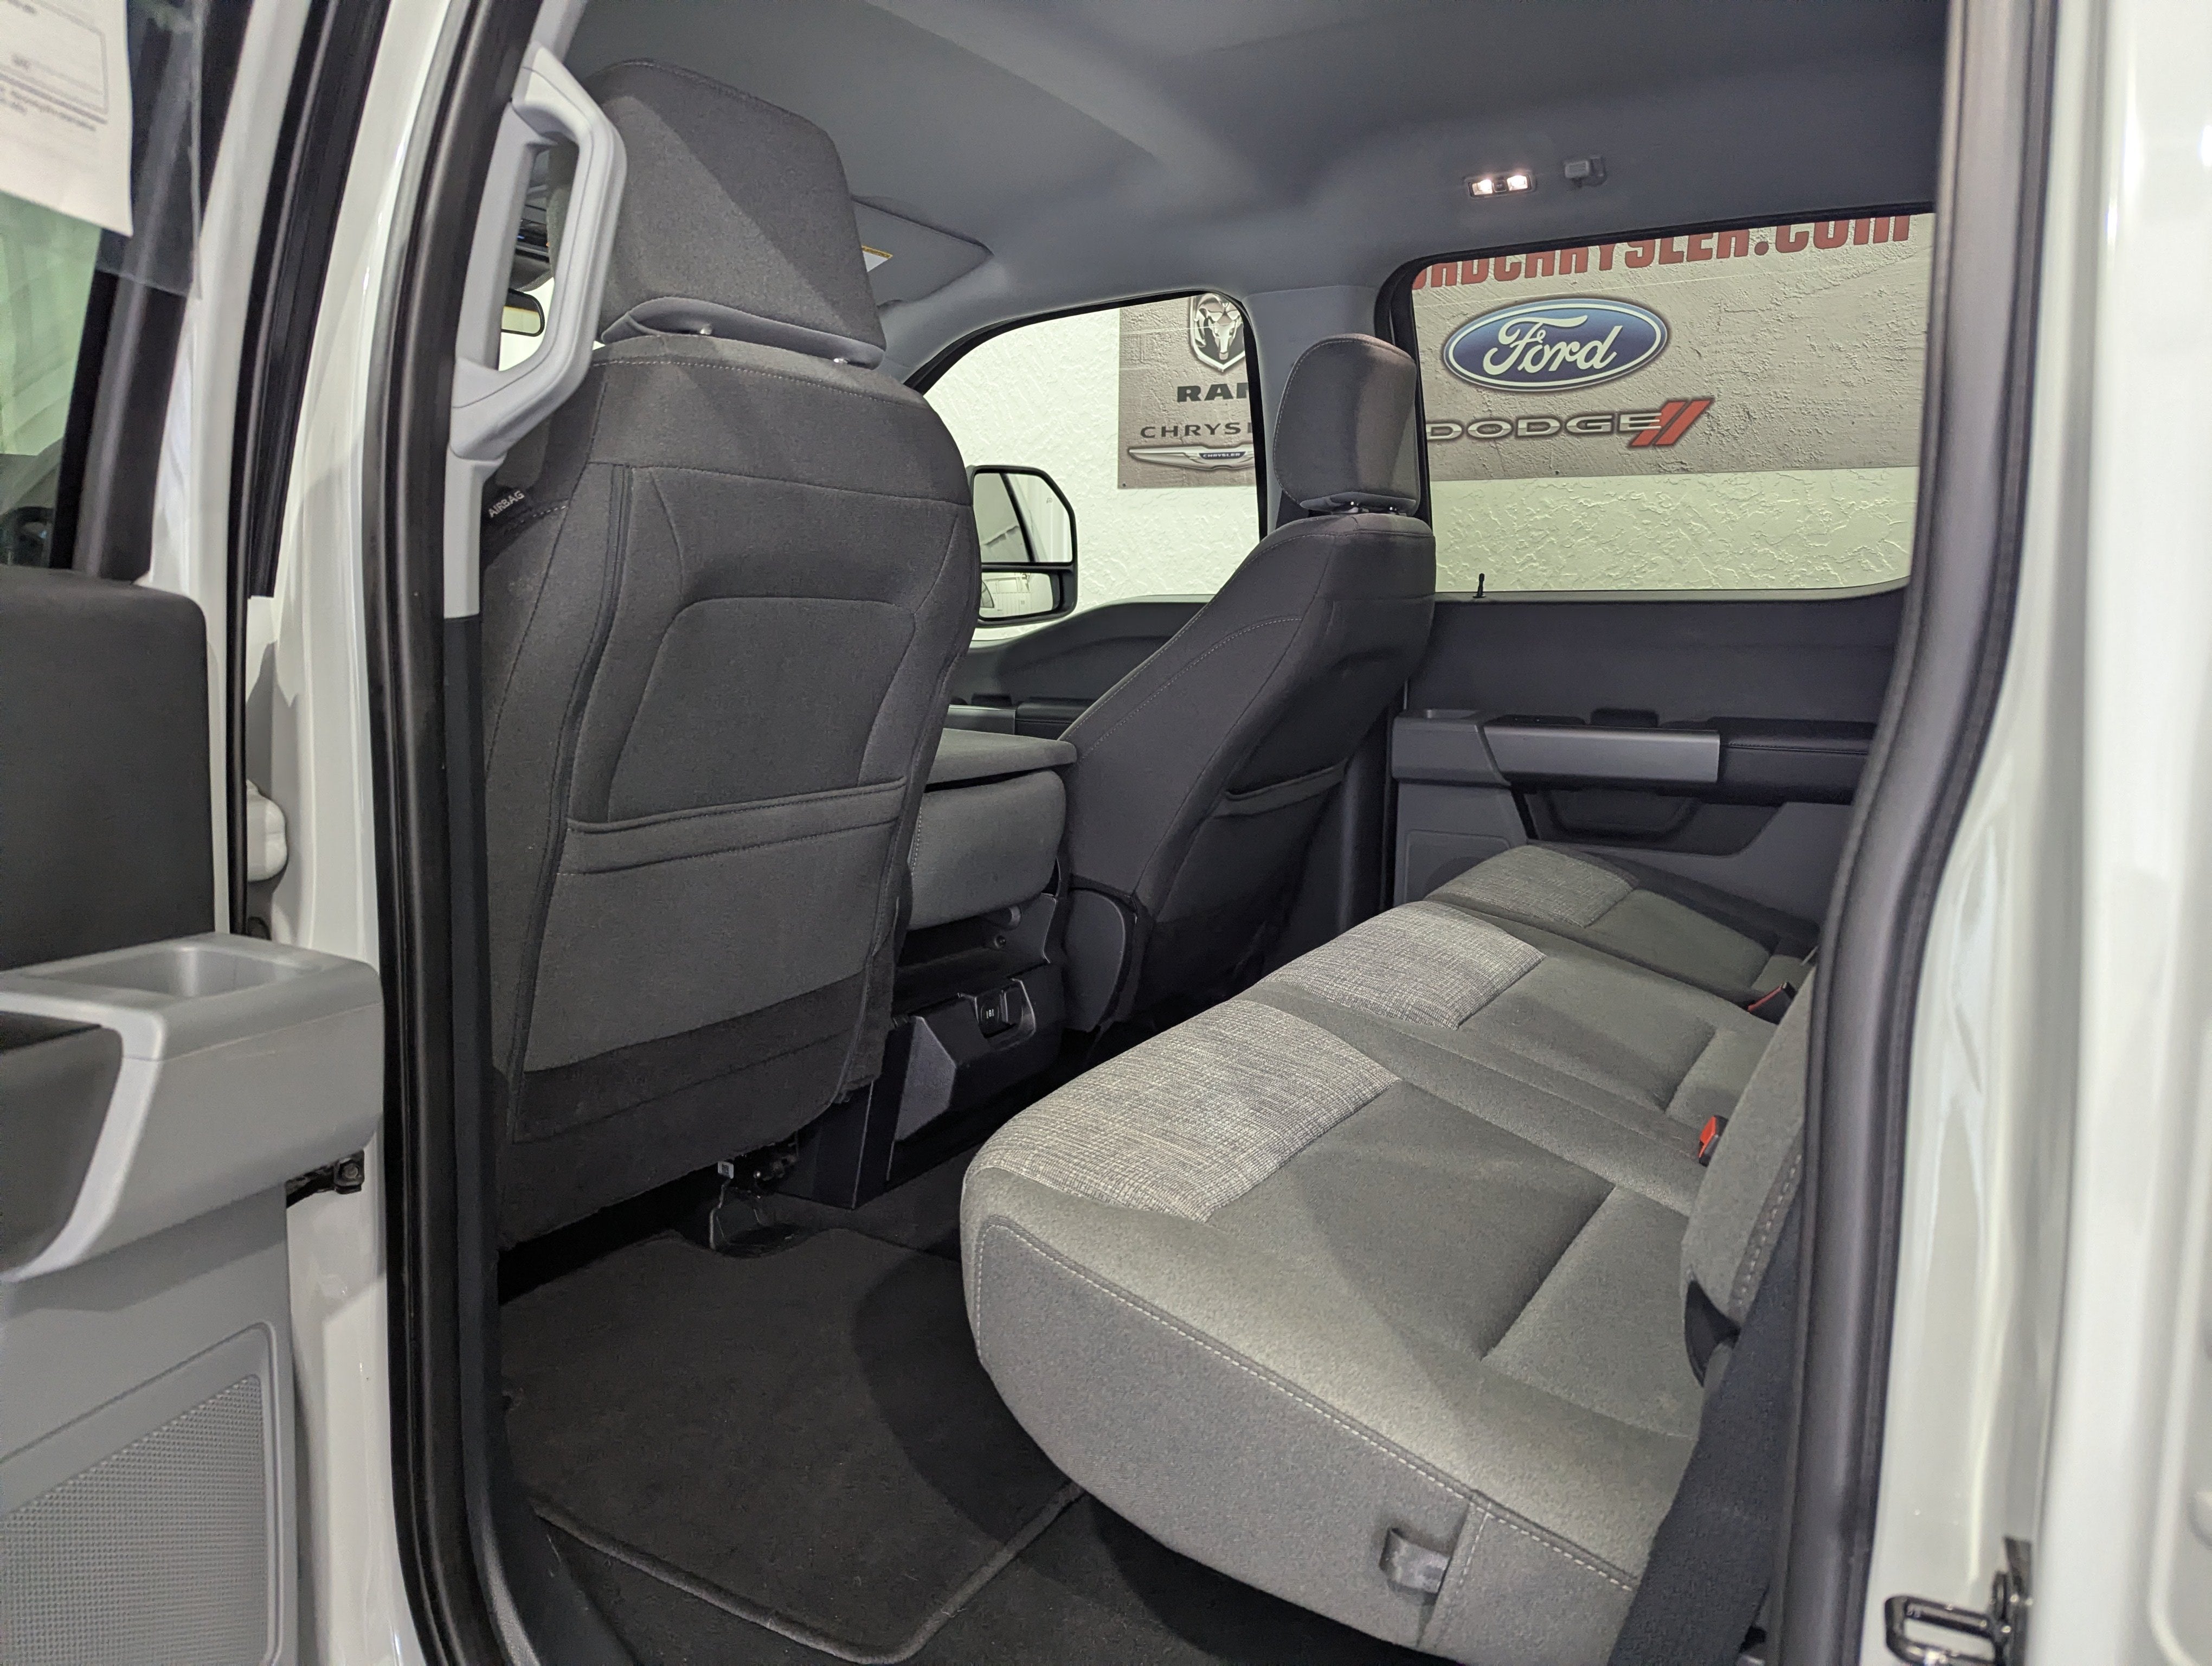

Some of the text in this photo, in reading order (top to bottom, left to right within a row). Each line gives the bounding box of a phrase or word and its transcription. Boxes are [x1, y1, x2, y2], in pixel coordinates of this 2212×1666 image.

[1483, 315, 1623, 375] Ford
[1140, 422, 1252, 438] CHRYS
[1426, 412, 1662, 441] DODGE
[488, 490, 525, 518] AIRBAG
